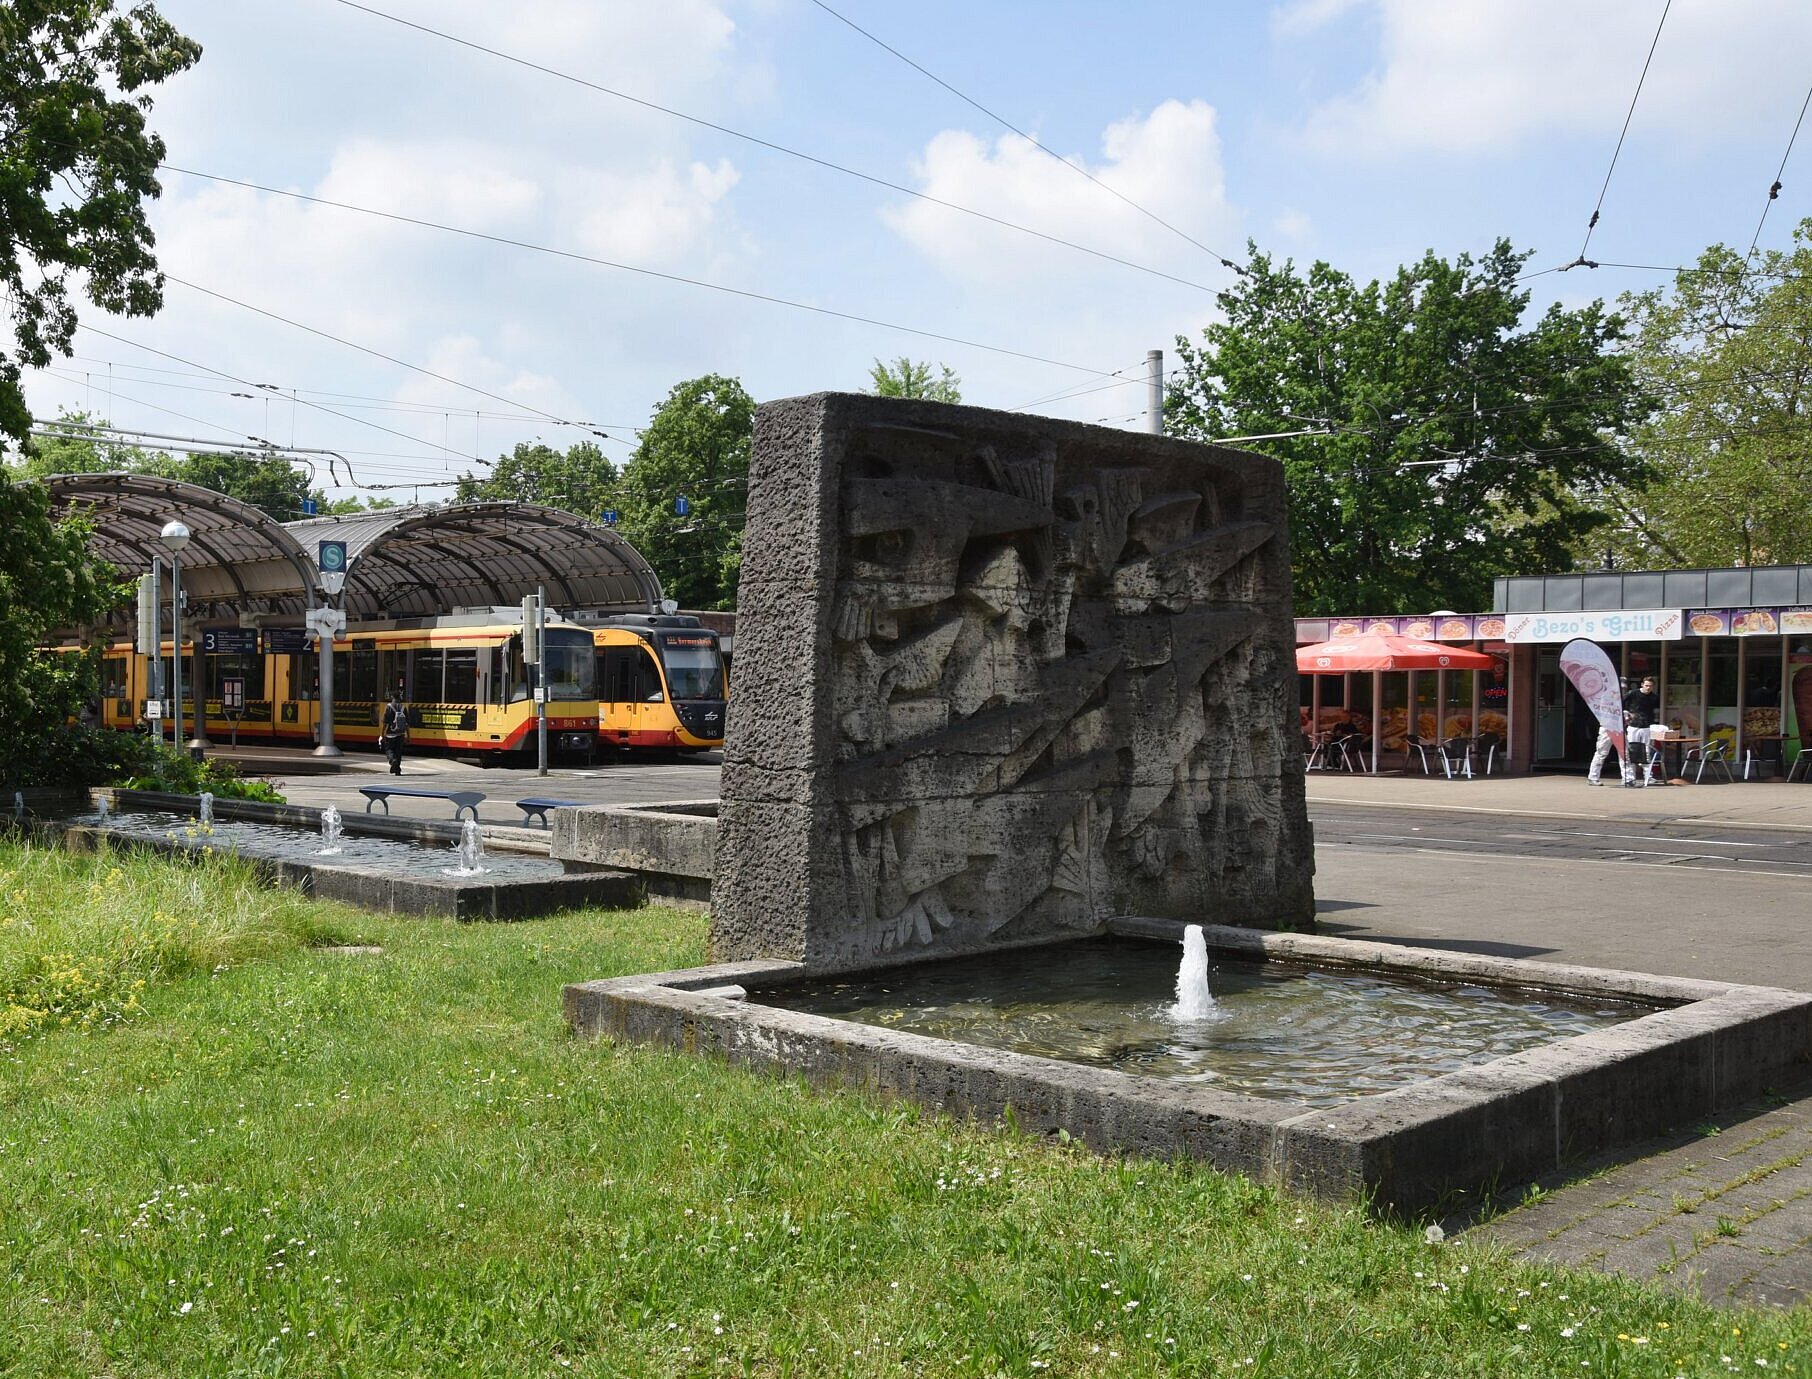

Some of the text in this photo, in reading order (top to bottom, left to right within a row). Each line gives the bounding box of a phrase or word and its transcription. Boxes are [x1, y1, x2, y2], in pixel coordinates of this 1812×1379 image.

[326, 547, 340, 566] S
[1507, 614, 1531, 640] Döner
[1532, 614, 1653, 639] Bezo's Grill
[1654, 612, 1679, 637] Pizza
[205, 633, 215, 650] 3
[303, 636, 311, 650] 2
[1484, 689, 1507, 697] OPEN
